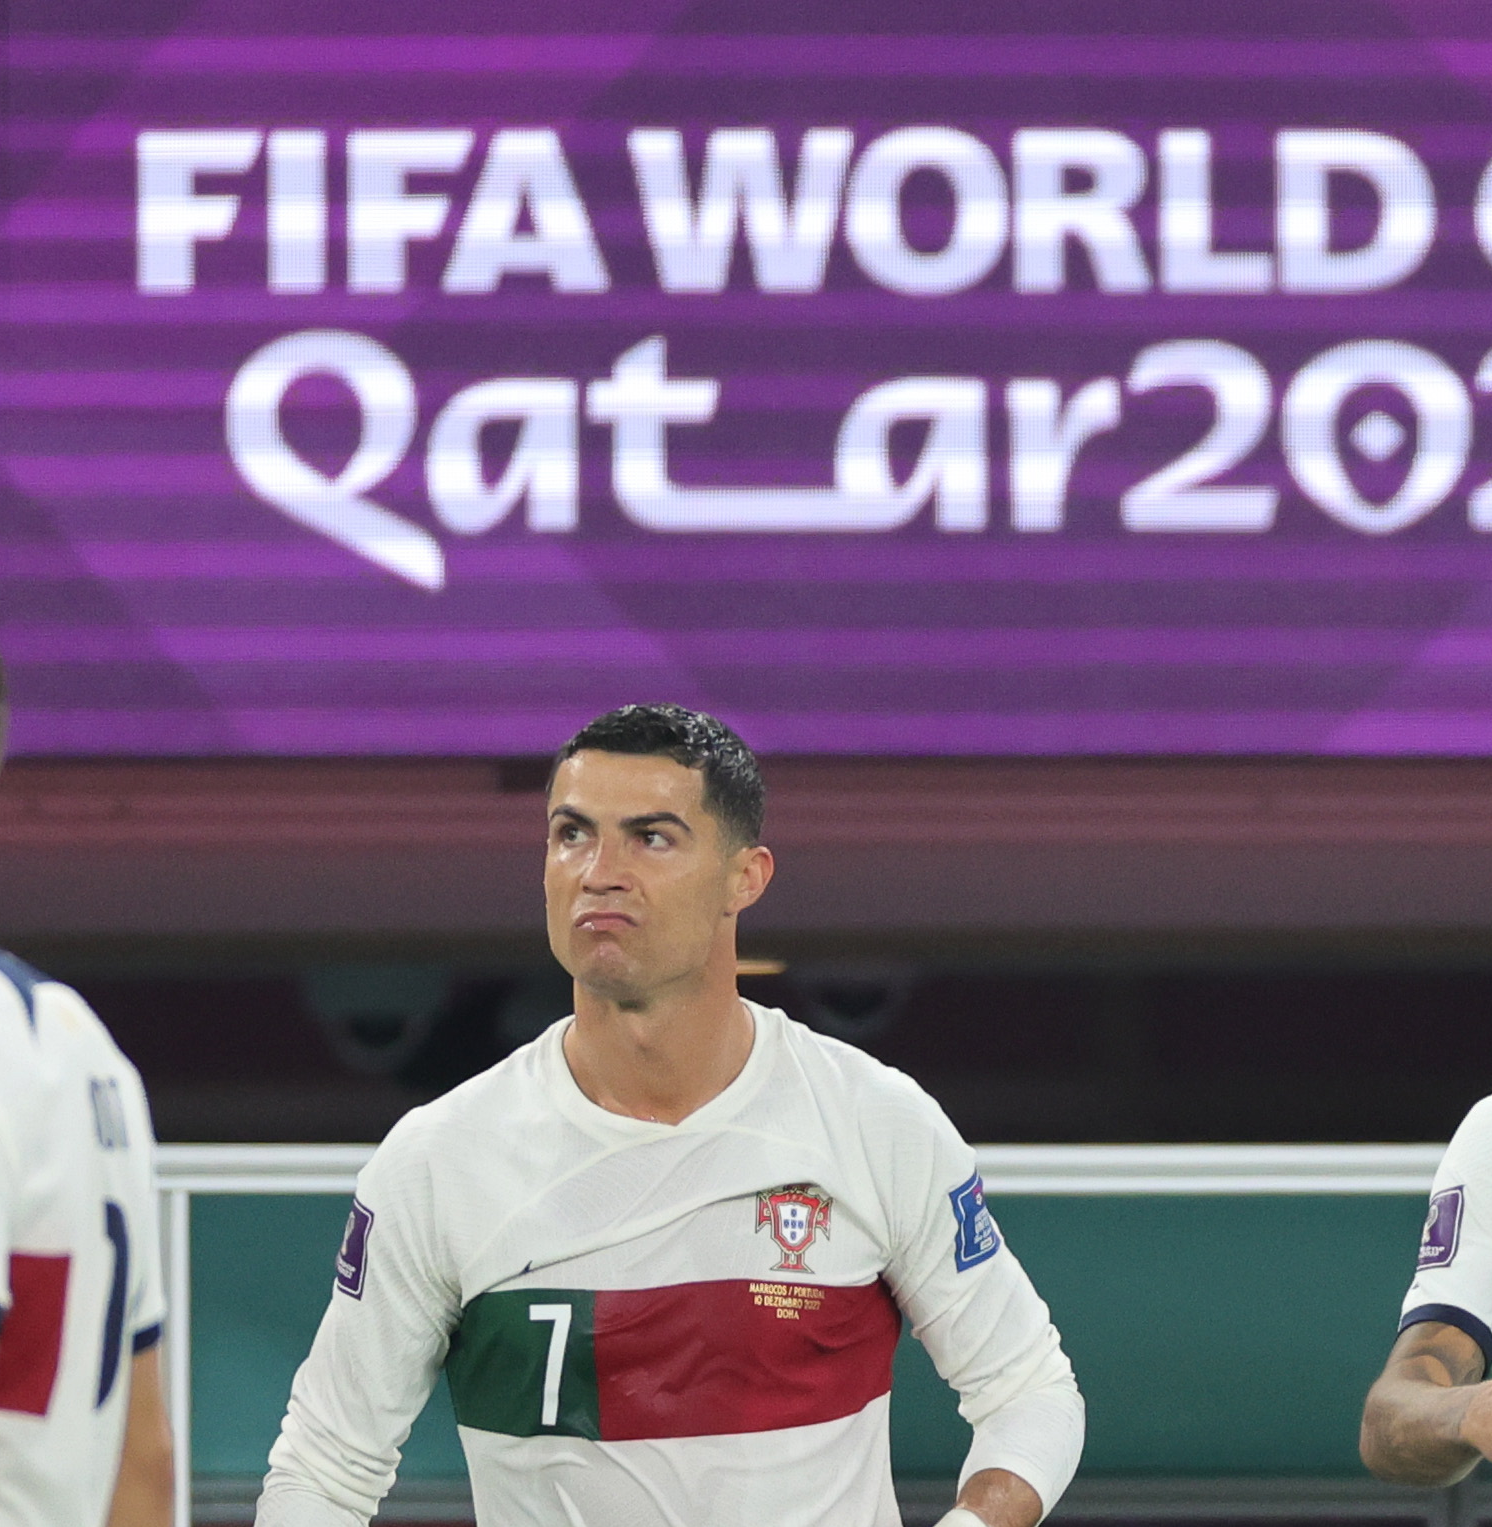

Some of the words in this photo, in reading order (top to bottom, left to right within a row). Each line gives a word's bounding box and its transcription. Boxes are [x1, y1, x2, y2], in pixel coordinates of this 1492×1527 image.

[134, 127, 611, 294] FIFA
[627, 127, 1439, 298] WORLD
[528, 1303, 572, 1426] 7
